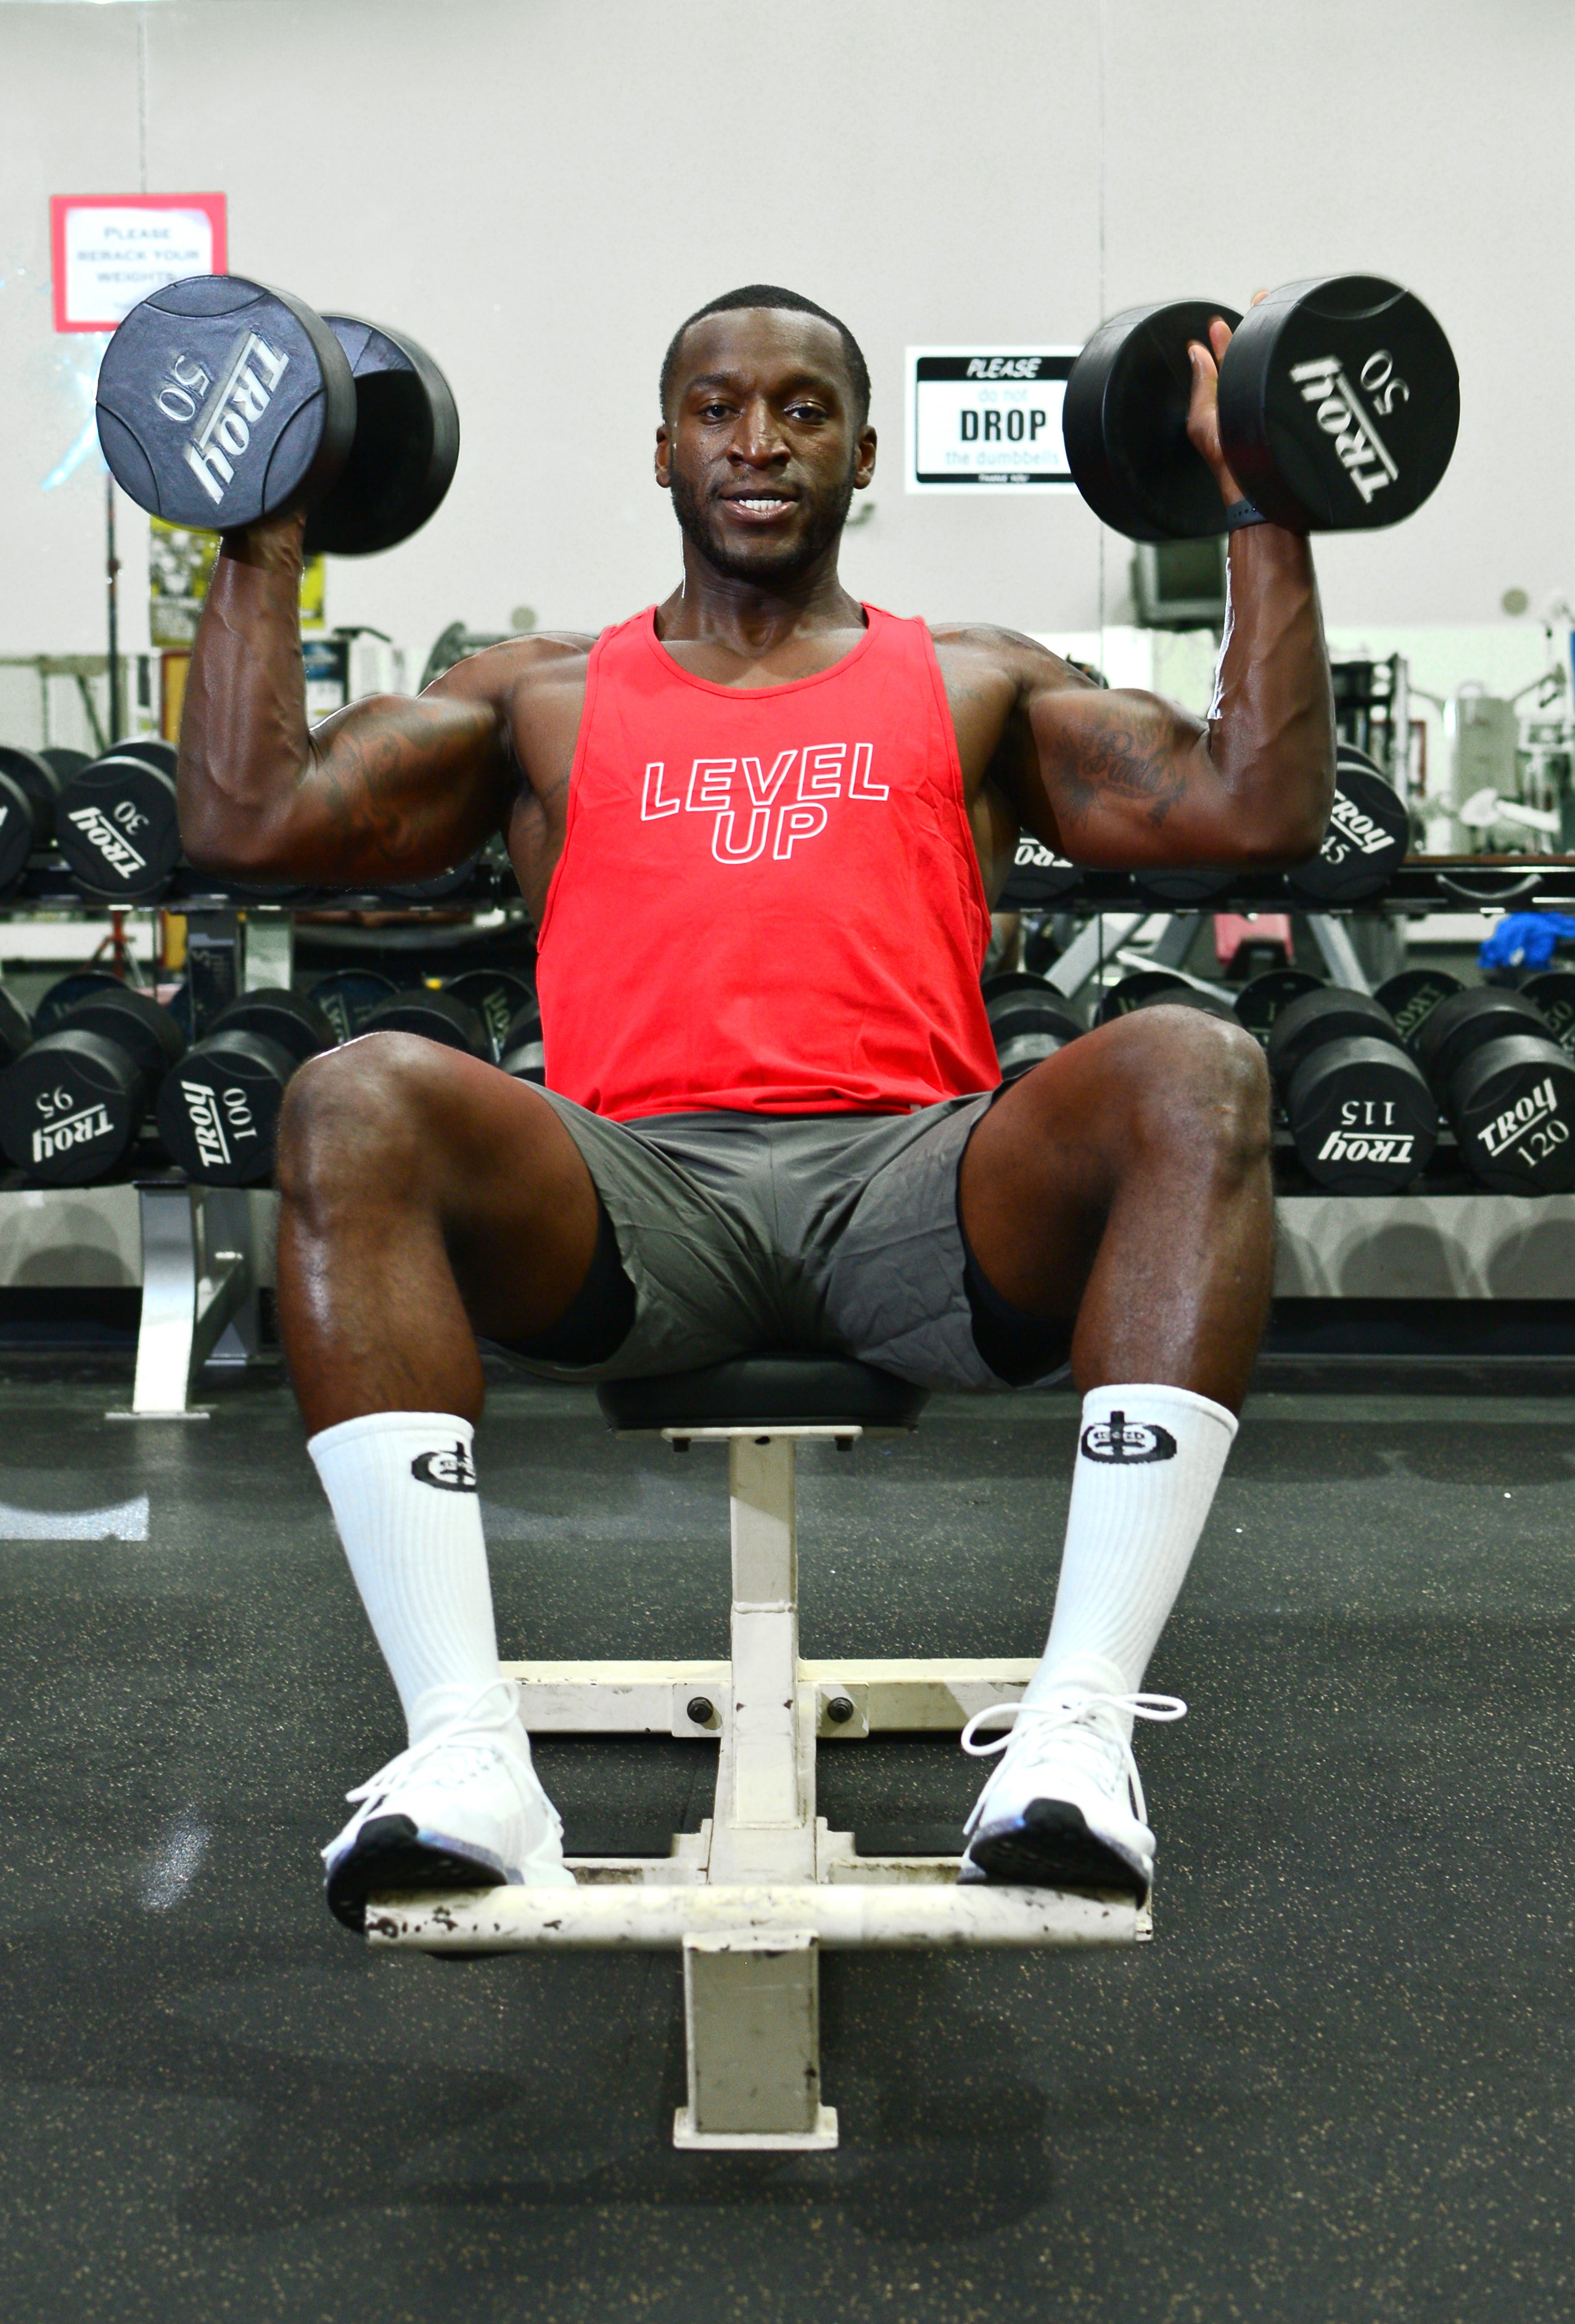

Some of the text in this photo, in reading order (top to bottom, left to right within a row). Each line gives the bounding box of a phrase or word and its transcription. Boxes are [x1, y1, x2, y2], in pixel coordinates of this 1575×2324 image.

[160, 354, 210, 421] 50
[966, 358, 1042, 379] PLEASE
[979, 388, 1028, 403] do not
[1361, 350, 1410, 416] 50
[187, 336, 289, 504] TROY
[961, 409, 1046, 441] DROP
[1289, 356, 1392, 504] TROY
[641, 742, 889, 821] LEVEL
[68, 807, 142, 879] TROY
[115, 801, 149, 835] 30
[712, 802, 828, 864] UP
[36, 1085, 73, 1119] 95
[181, 1080, 224, 1167] TROY
[223, 1088, 257, 1141] 100
[1341, 1101, 1395, 1126] 115
[1478, 1076, 1557, 1151] TROY
[33, 1110, 114, 1164] TROY
[1318, 1130, 1413, 1163] TROY
[1518, 1119, 1569, 1167] 120
